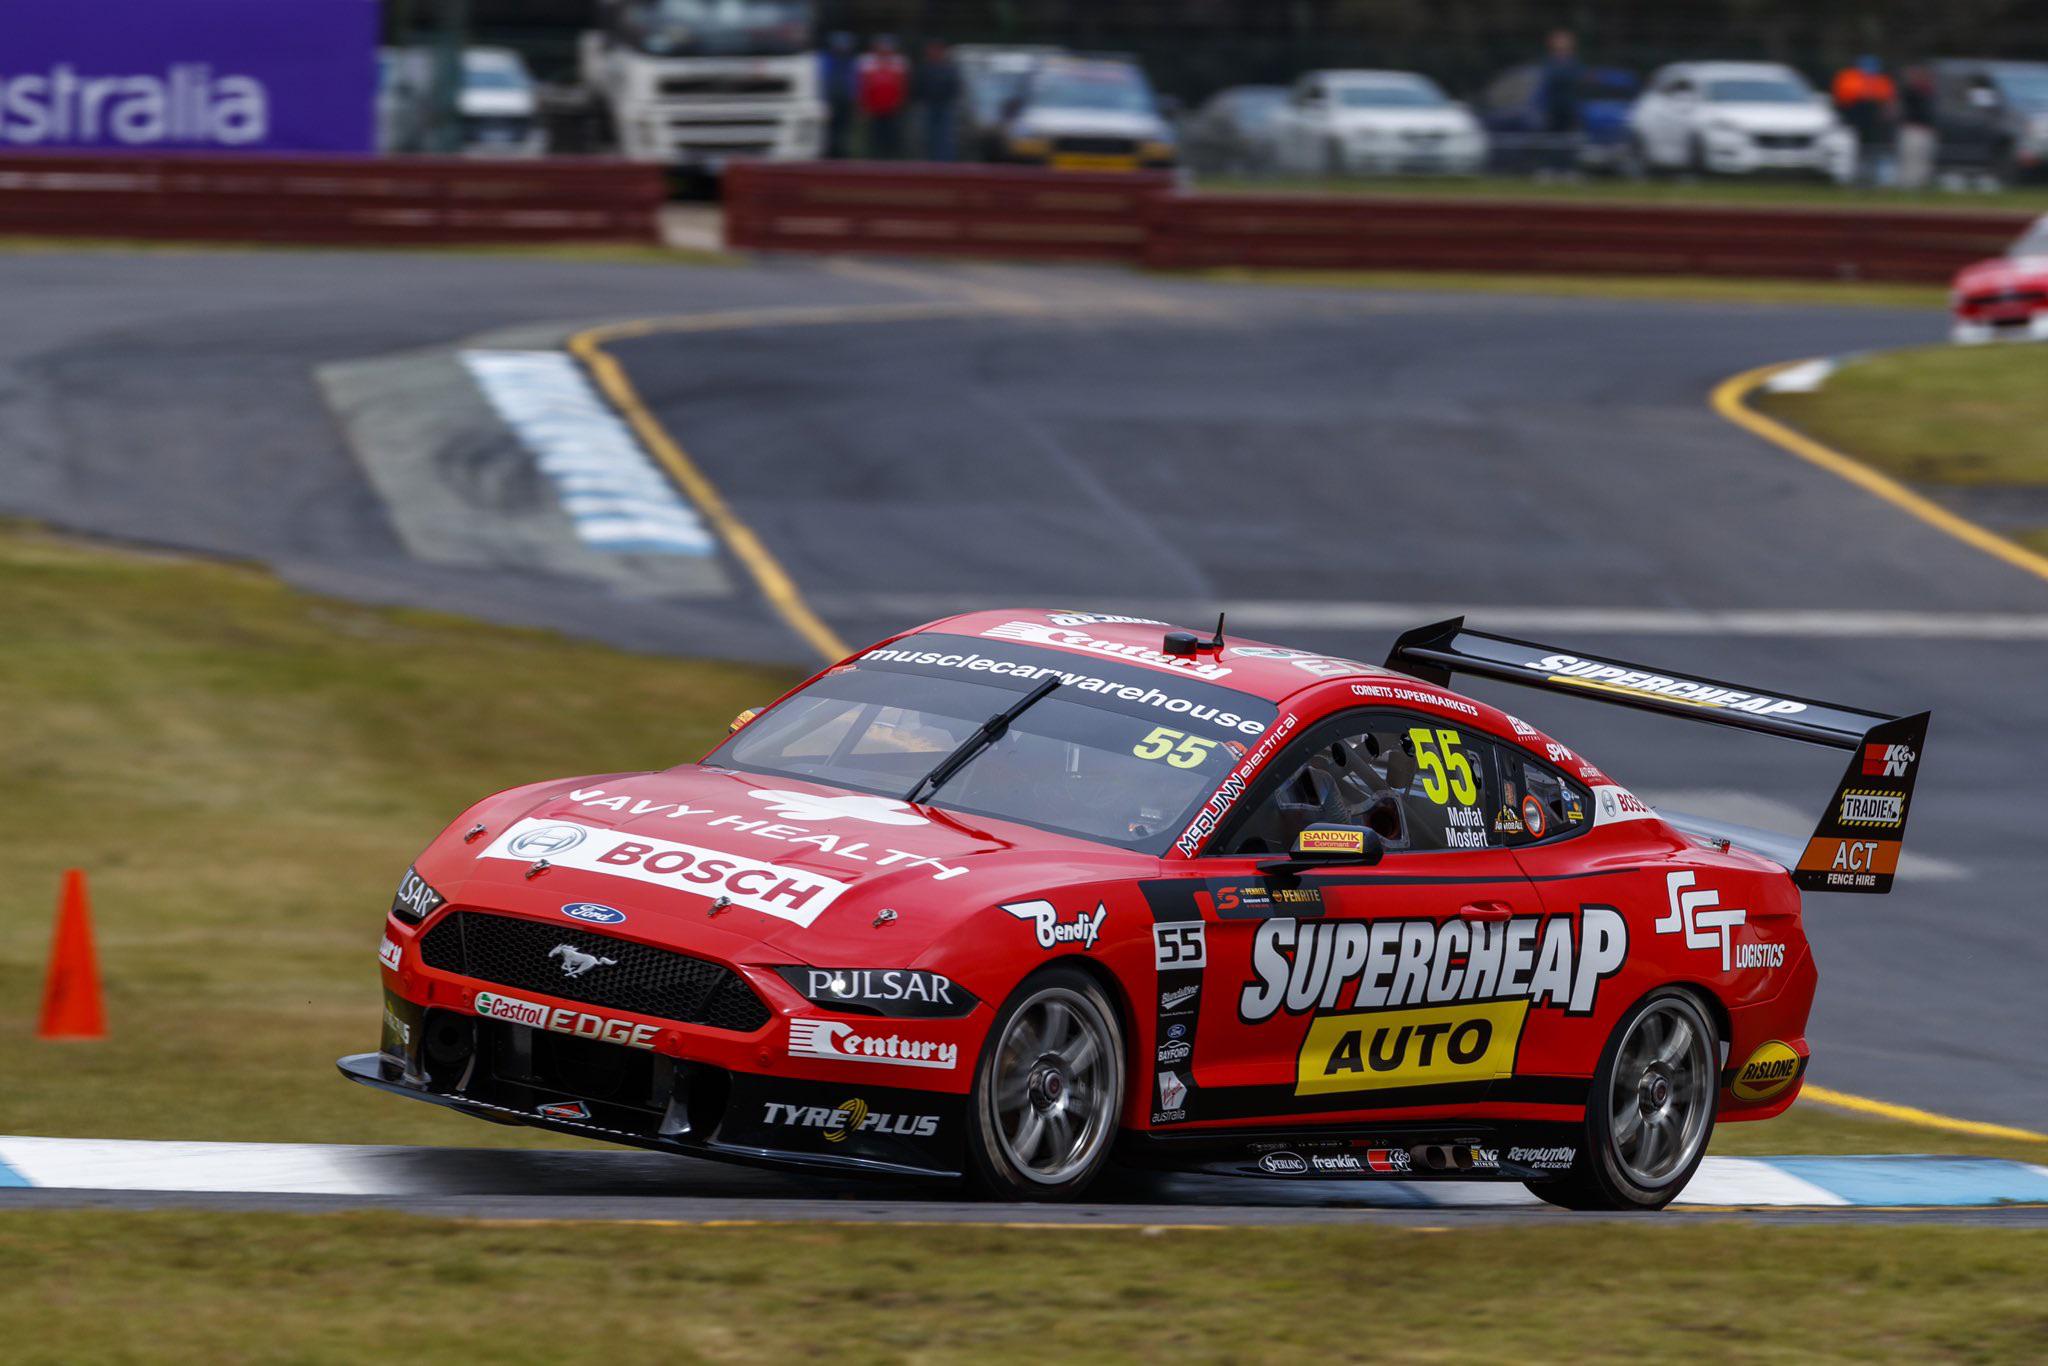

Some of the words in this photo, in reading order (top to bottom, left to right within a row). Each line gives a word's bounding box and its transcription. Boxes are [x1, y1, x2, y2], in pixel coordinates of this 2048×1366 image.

[0, 63, 268, 145] stralia
[858, 650, 1266, 735] musclecarwarehouse
[1351, 684, 1393, 698] CORNETTS
[1395, 687, 1479, 717] SUPERMARKETS
[1525, 655, 1808, 715] SUPERCHEAP
[1132, 726, 1218, 769] 55
[1240, 712, 1298, 779] electrical
[1409, 728, 1477, 806] 55
[1447, 807, 1485, 827] Moffat
[1616, 793, 1649, 813] BOSC
[1846, 798, 1887, 819] TRADIE
[707, 814, 970, 882] HEALTH
[1303, 832, 1360, 842] SANDVIK
[1445, 828, 1489, 848] Mostert
[1832, 841, 1878, 872] ACT
[595, 840, 825, 911] BOSCH
[1827, 873, 1854, 885] FENCE
[1855, 874, 1876, 885] HIRE
[571, 904, 615, 921] Ford
[1282, 889, 1321, 903] PENRITE
[998, 899, 1107, 949] Bendix
[1655, 870, 1746, 972] SCT
[1157, 927, 1203, 963] 55
[1736, 943, 1785, 968] LOGISTICS
[1239, 908, 1626, 1021] SUPERCHEAP
[807, 970, 953, 1005] PULSAR
[492, 998, 542, 1025] Castrol
[548, 1008, 662, 1050] EDGE
[788, 1018, 957, 1069] Century
[1158, 1047, 1189, 1061] BAYFORD
[1324, 1018, 1493, 1075] AUTO
[1152, 1110, 1185, 1123] australia
[1264, 1156, 1303, 1172] SPERLING
[1312, 1154, 1360, 1169] franklin
[1507, 1147, 1577, 1163] REVOLUTION
[1532, 1160, 1573, 1169] RACEGEAR
